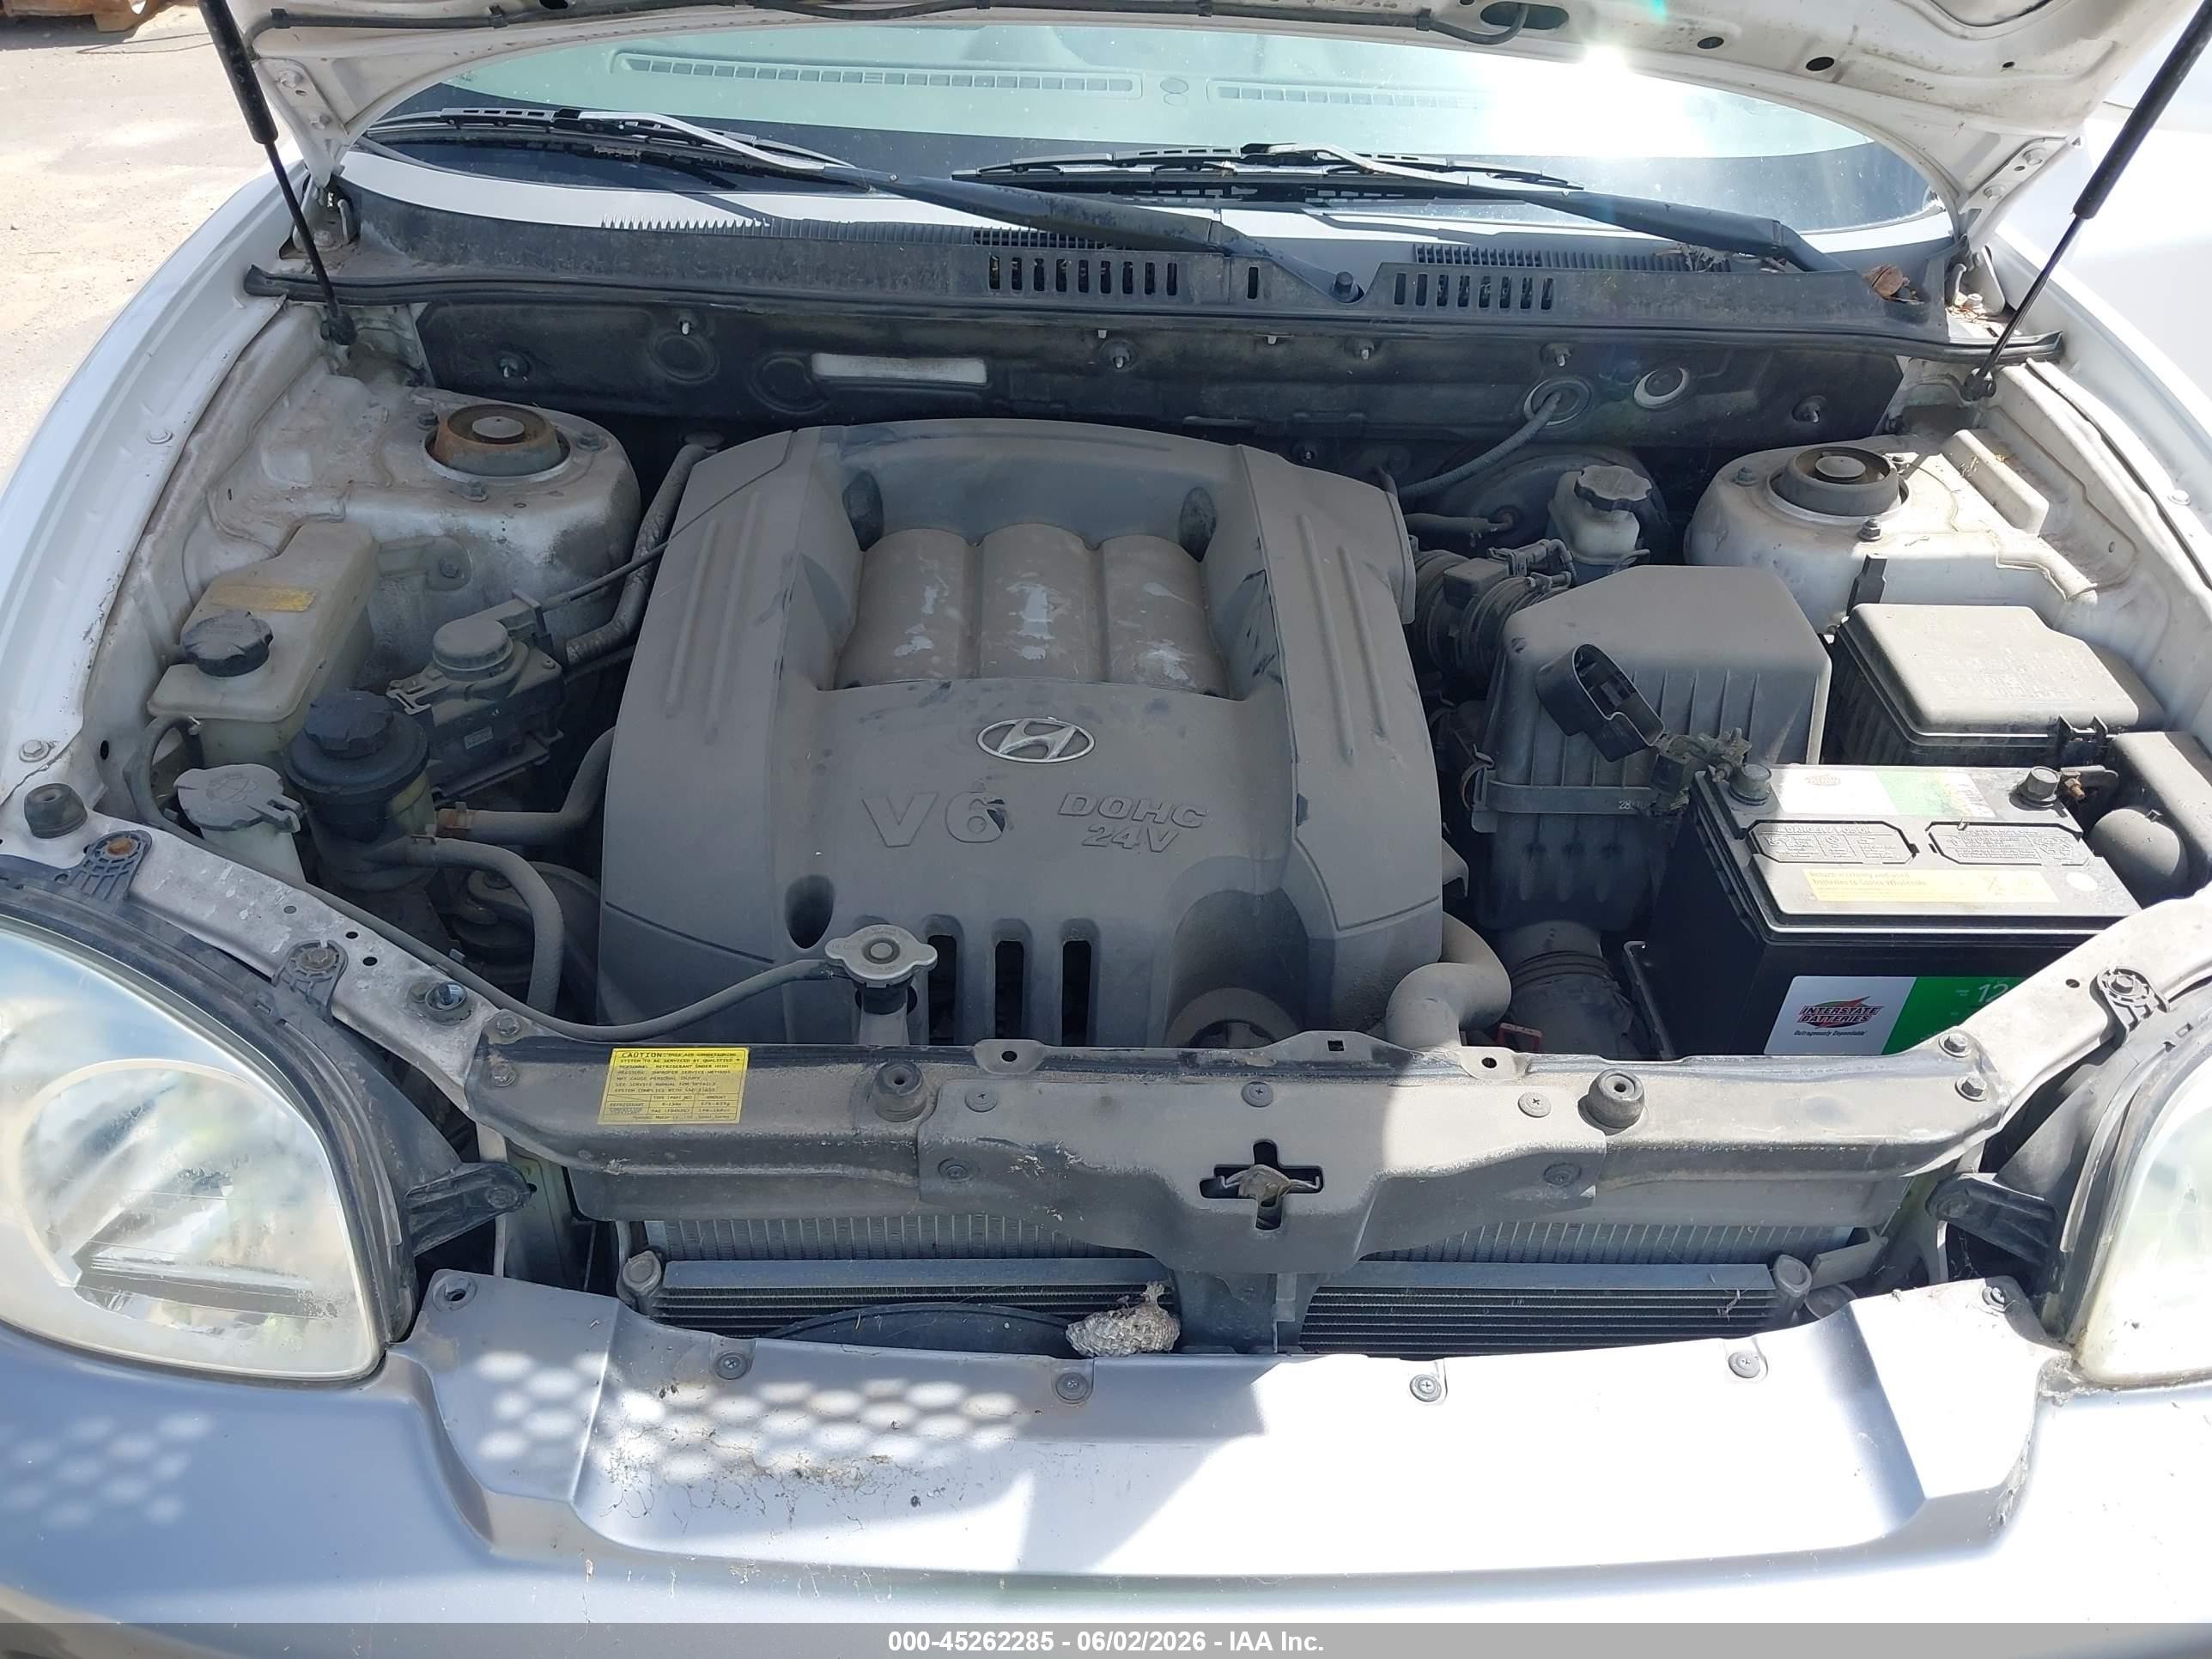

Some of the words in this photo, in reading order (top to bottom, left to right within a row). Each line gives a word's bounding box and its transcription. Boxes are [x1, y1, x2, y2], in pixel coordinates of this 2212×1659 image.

[861, 791, 1006, 848] V6
[1058, 792, 1206, 829] DOHC
[1082, 823, 1179, 854] 24V
